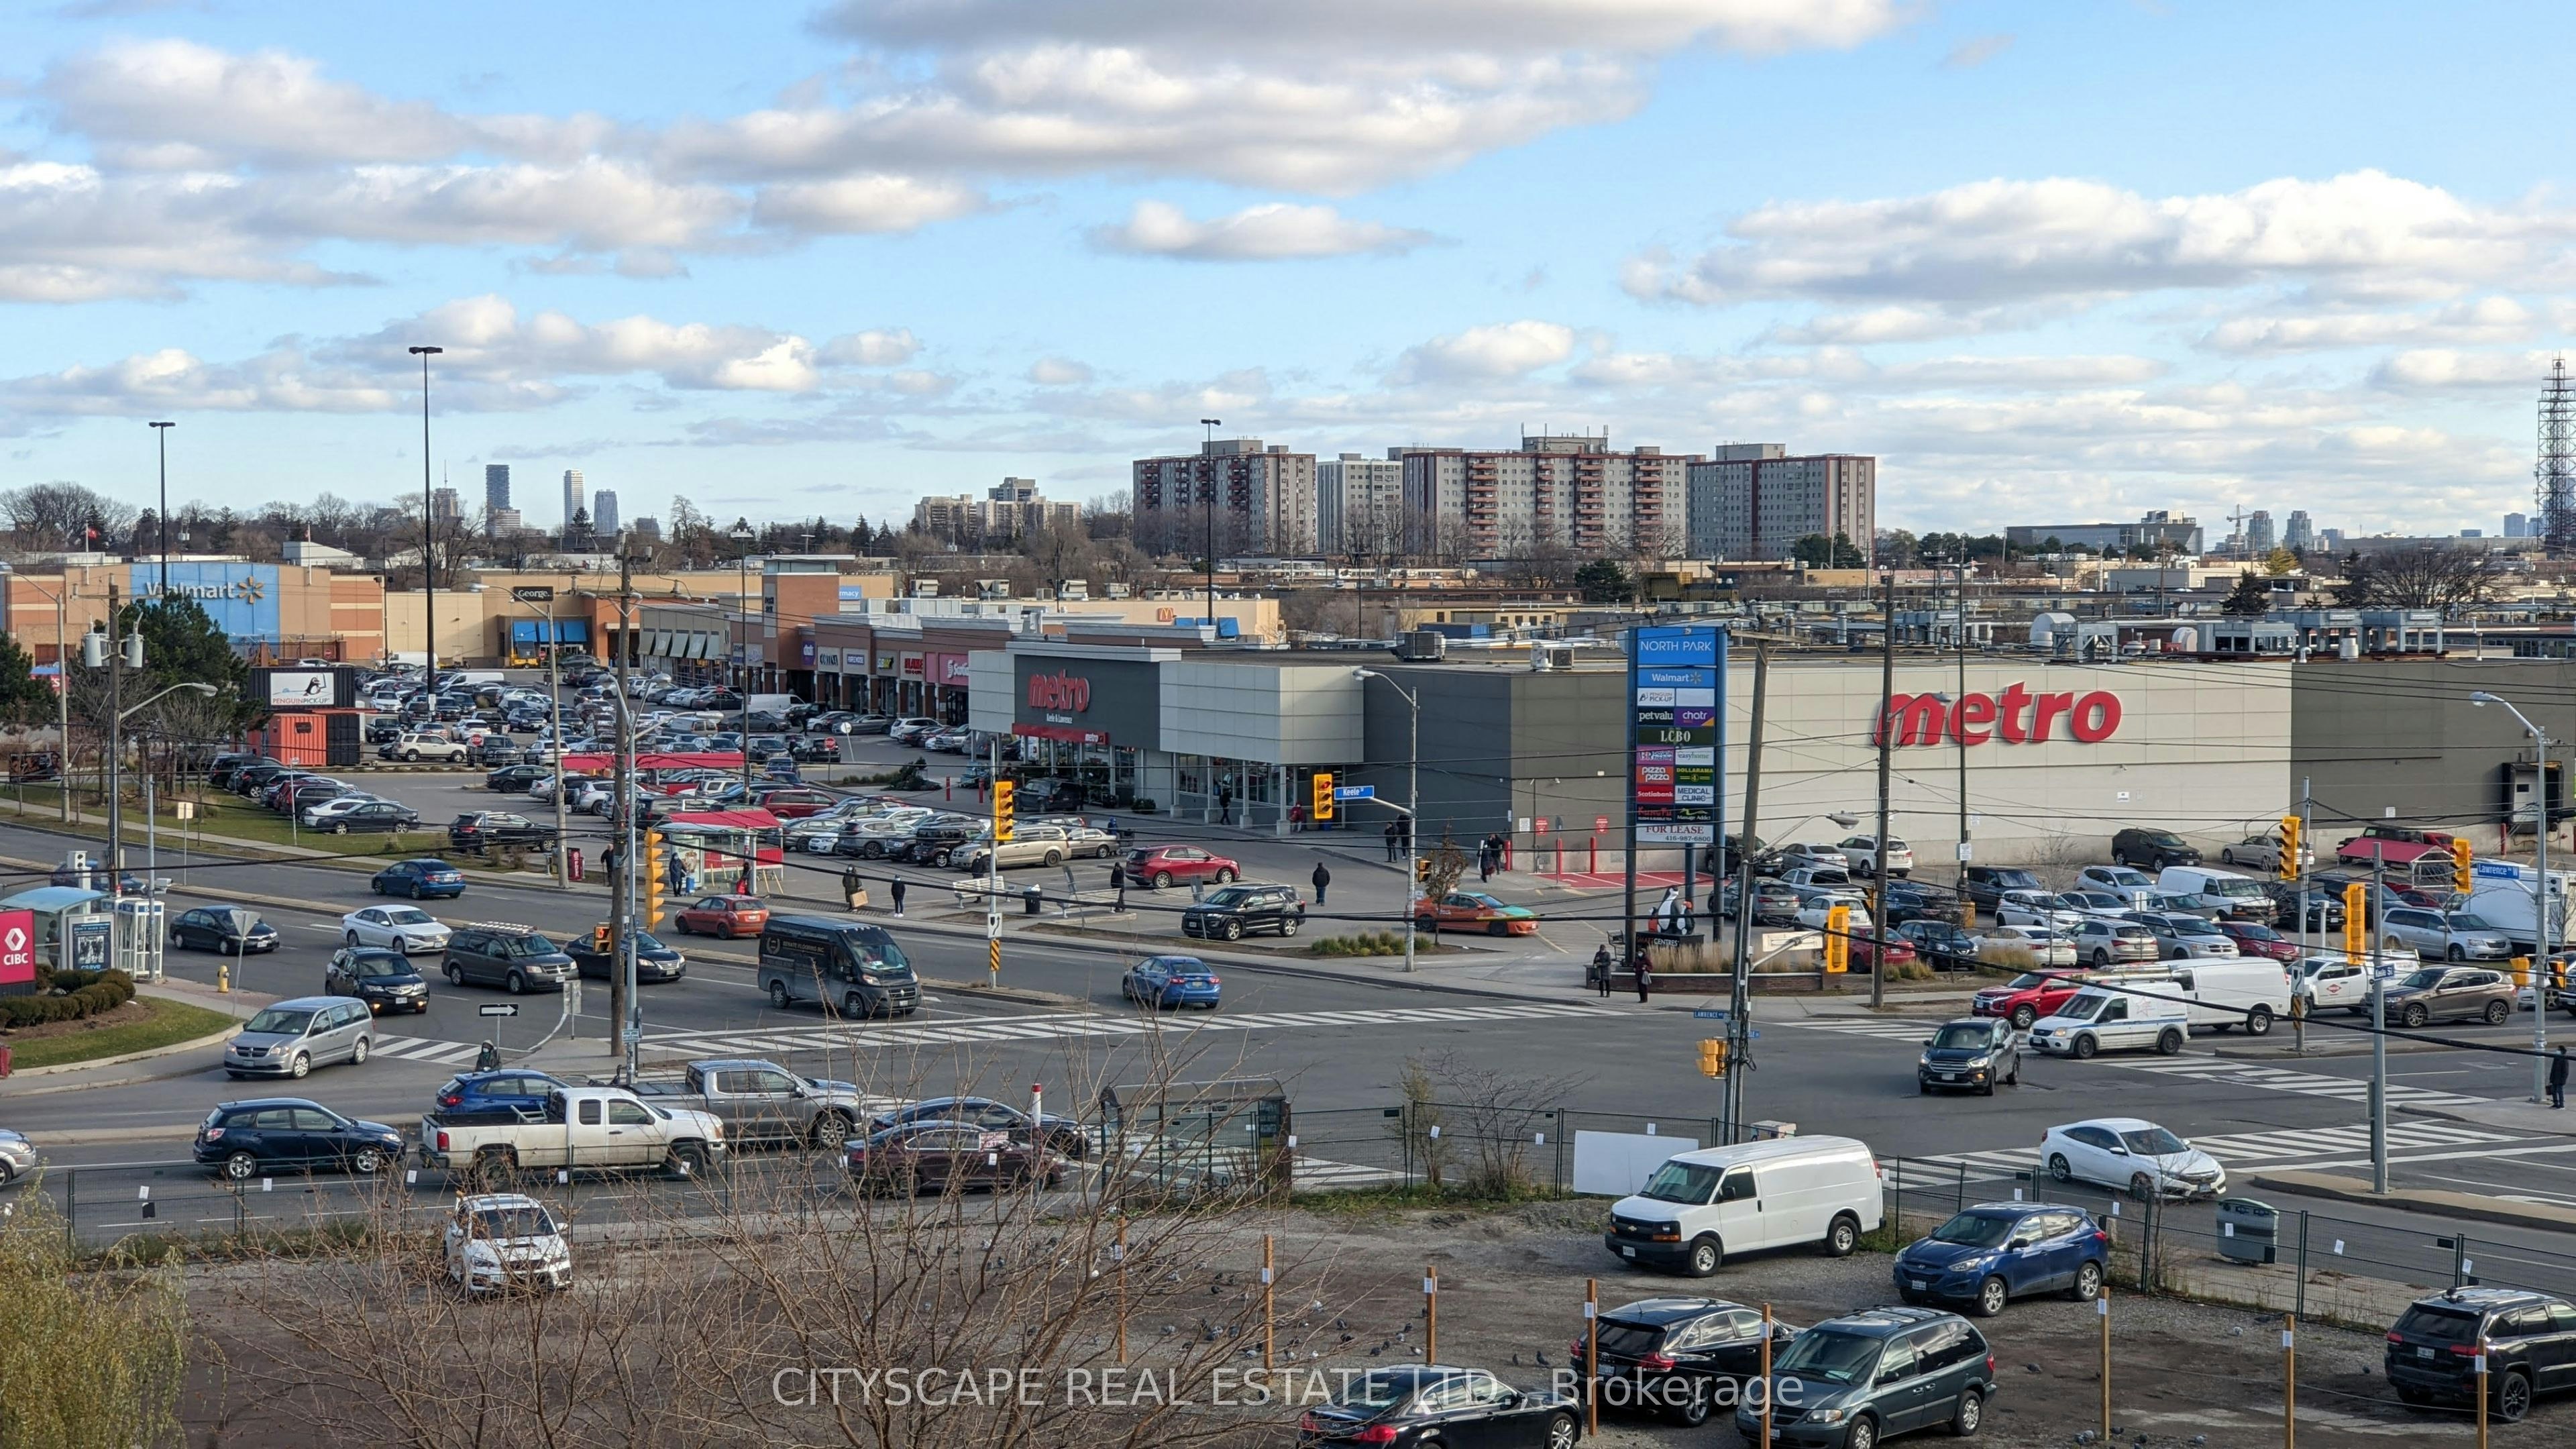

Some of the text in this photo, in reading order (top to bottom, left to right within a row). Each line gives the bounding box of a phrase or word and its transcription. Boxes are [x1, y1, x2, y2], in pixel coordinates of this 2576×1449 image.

[1640, 641, 1712, 651] NORTH PARK
[1652, 674, 1690, 682] Walmart
[1028, 669, 1090, 712] metro
[1638, 711, 1674, 722] petvalu
[1682, 711, 1707, 720] chatr
[1874, 681, 2122, 746] metro
[1085, 733, 1099, 742] metro
[1660, 730, 1691, 742] LCBO
[1678, 751, 1710, 760] easyhome
[1642, 767, 1666, 775] pizza
[1646, 773, 1670, 782] pizza
[1342, 788, 1360, 796] Keele
[2479, 863, 2507, 875] Lawrence
[2513, 867, 2518, 876] W
[3, 952, 29, 965] CIBC
